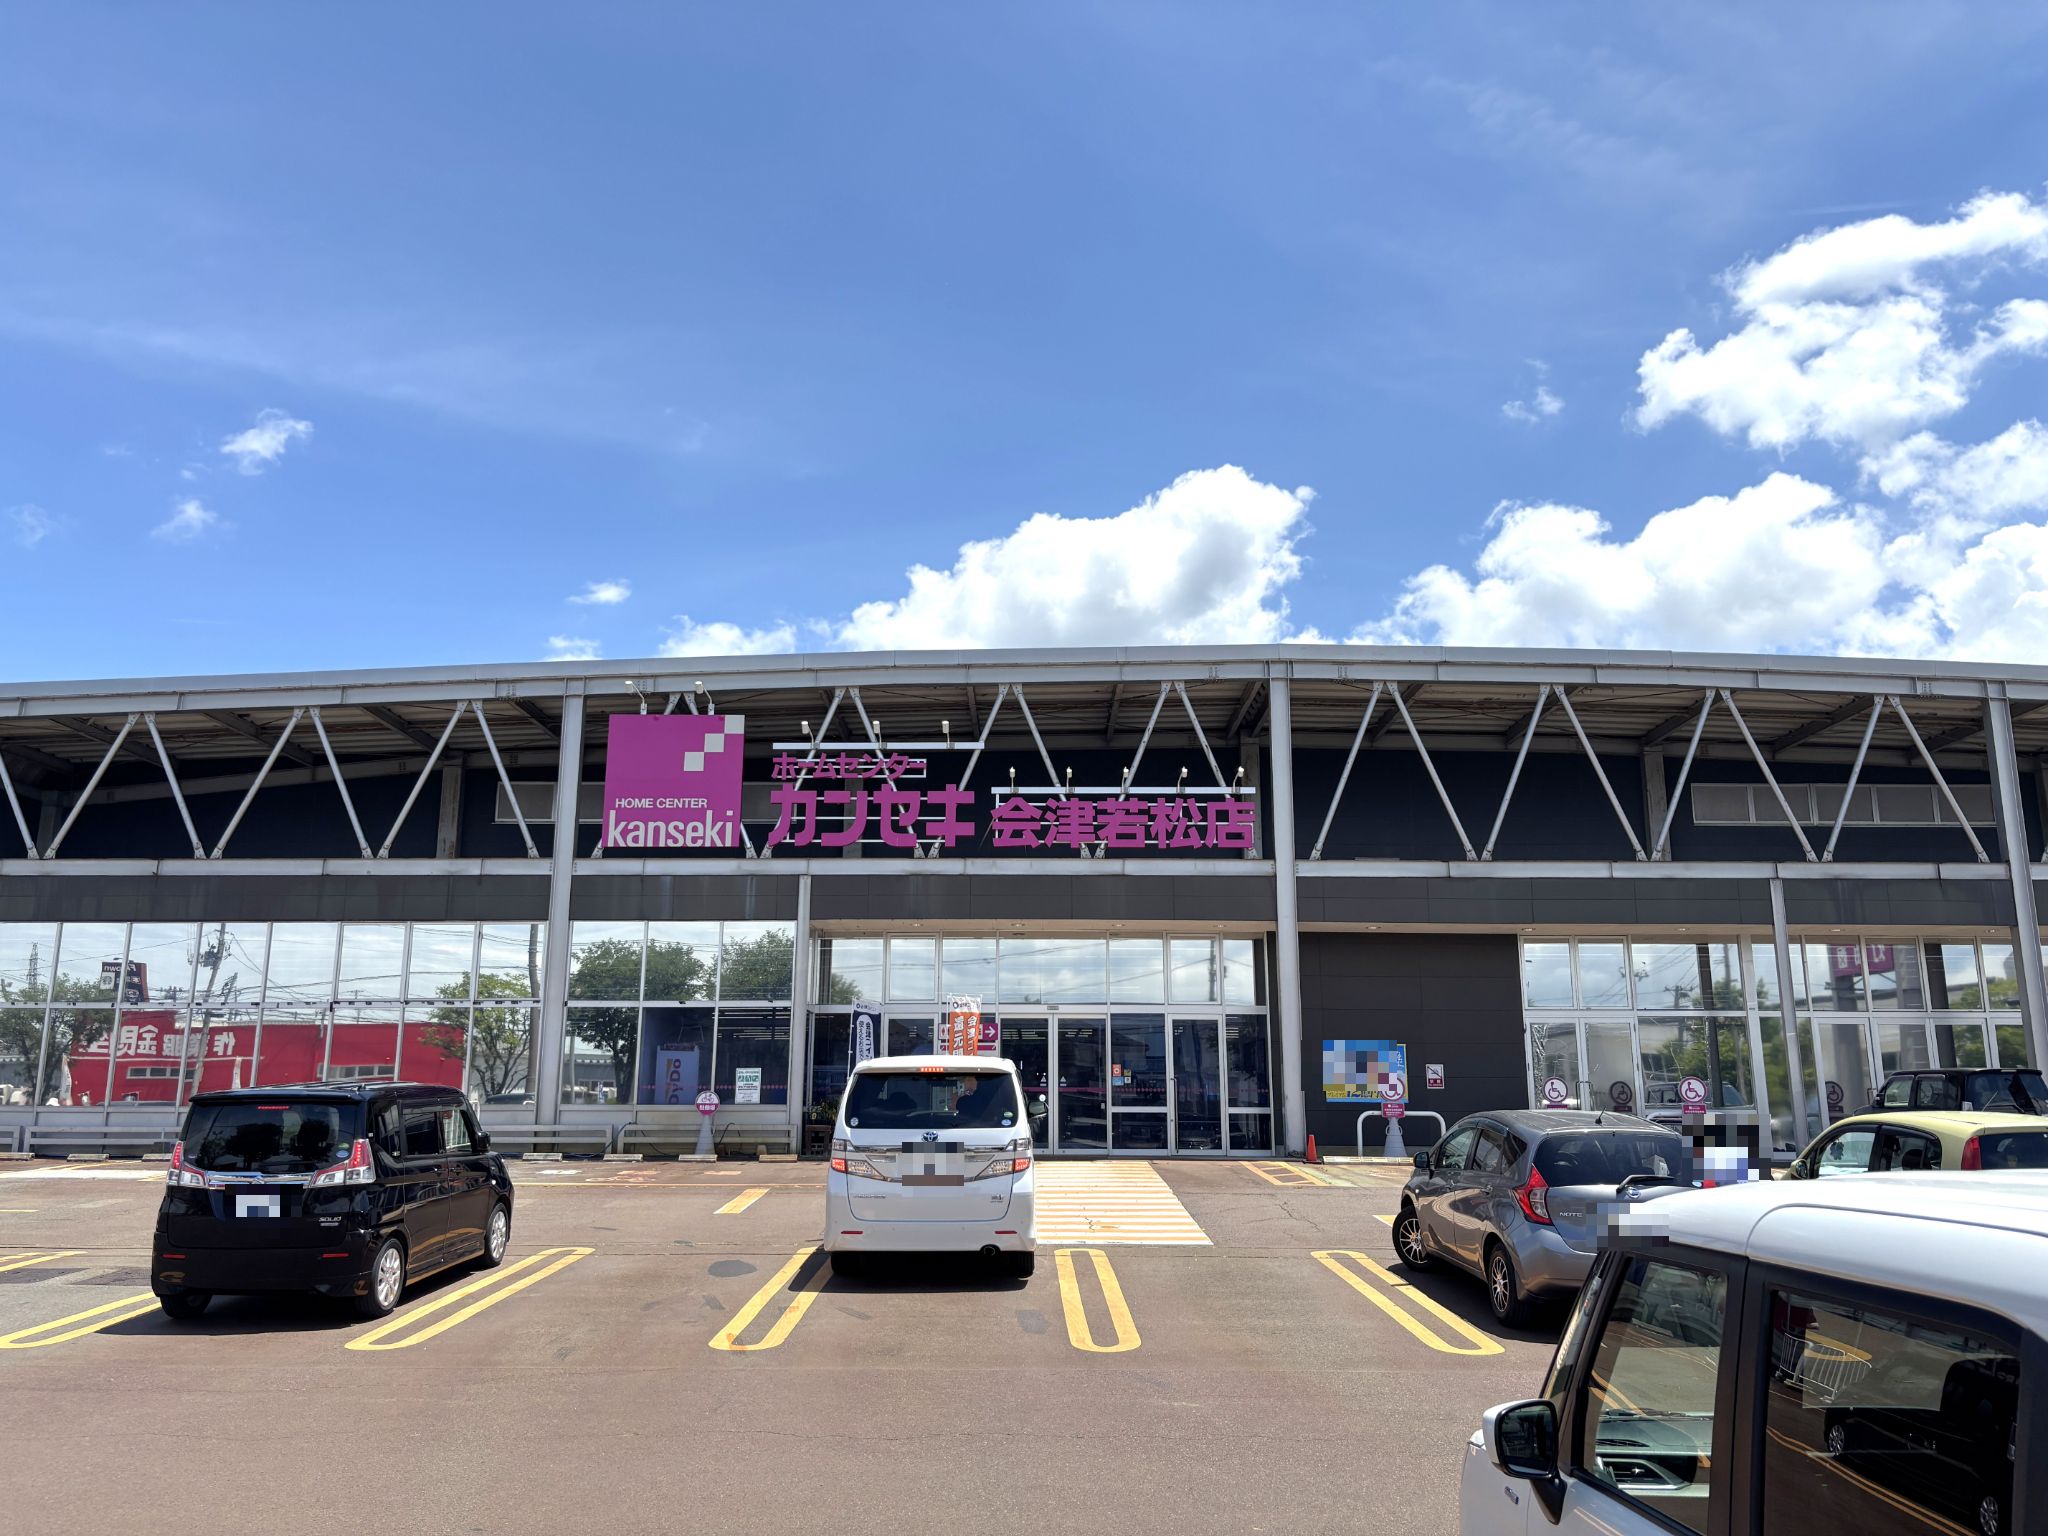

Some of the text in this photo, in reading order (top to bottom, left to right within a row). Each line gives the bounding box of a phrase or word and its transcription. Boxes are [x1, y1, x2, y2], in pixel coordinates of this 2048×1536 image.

[771, 752, 927, 780] ホームセンター
[615, 798, 708, 808] HOME CENTER
[768, 783, 1256, 848] カンセキ 会津若松店
[607, 810, 734, 847] kanseki
[967, 1016, 978, 1056] 会津コ
